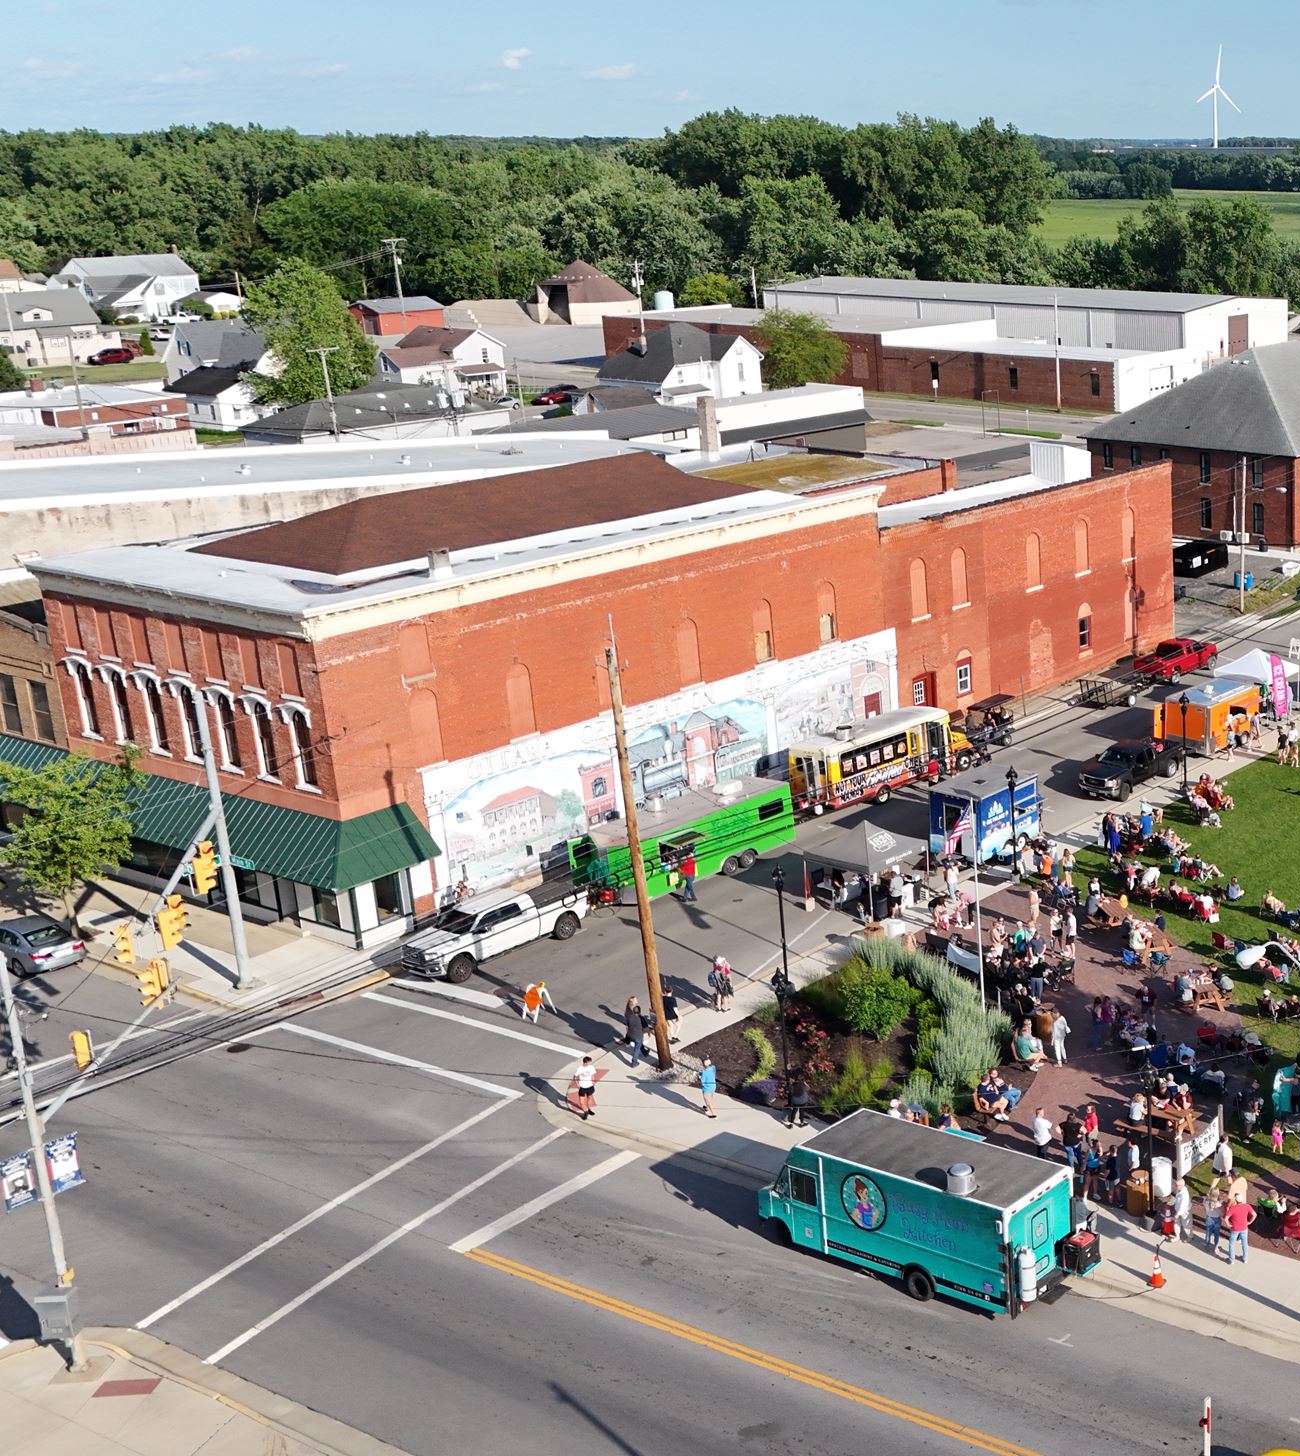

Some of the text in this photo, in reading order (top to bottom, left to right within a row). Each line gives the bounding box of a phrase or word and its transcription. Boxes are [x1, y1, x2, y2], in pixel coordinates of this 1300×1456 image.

[466, 641, 869, 780] OTTAWA CEEBRATION OF PROGRESS
[835, 780, 849, 795] NOT
[850, 773, 866, 789] YOUR
[886, 1192, 928, 1224] Busy
[901, 1217, 957, 1252] Kitchen
